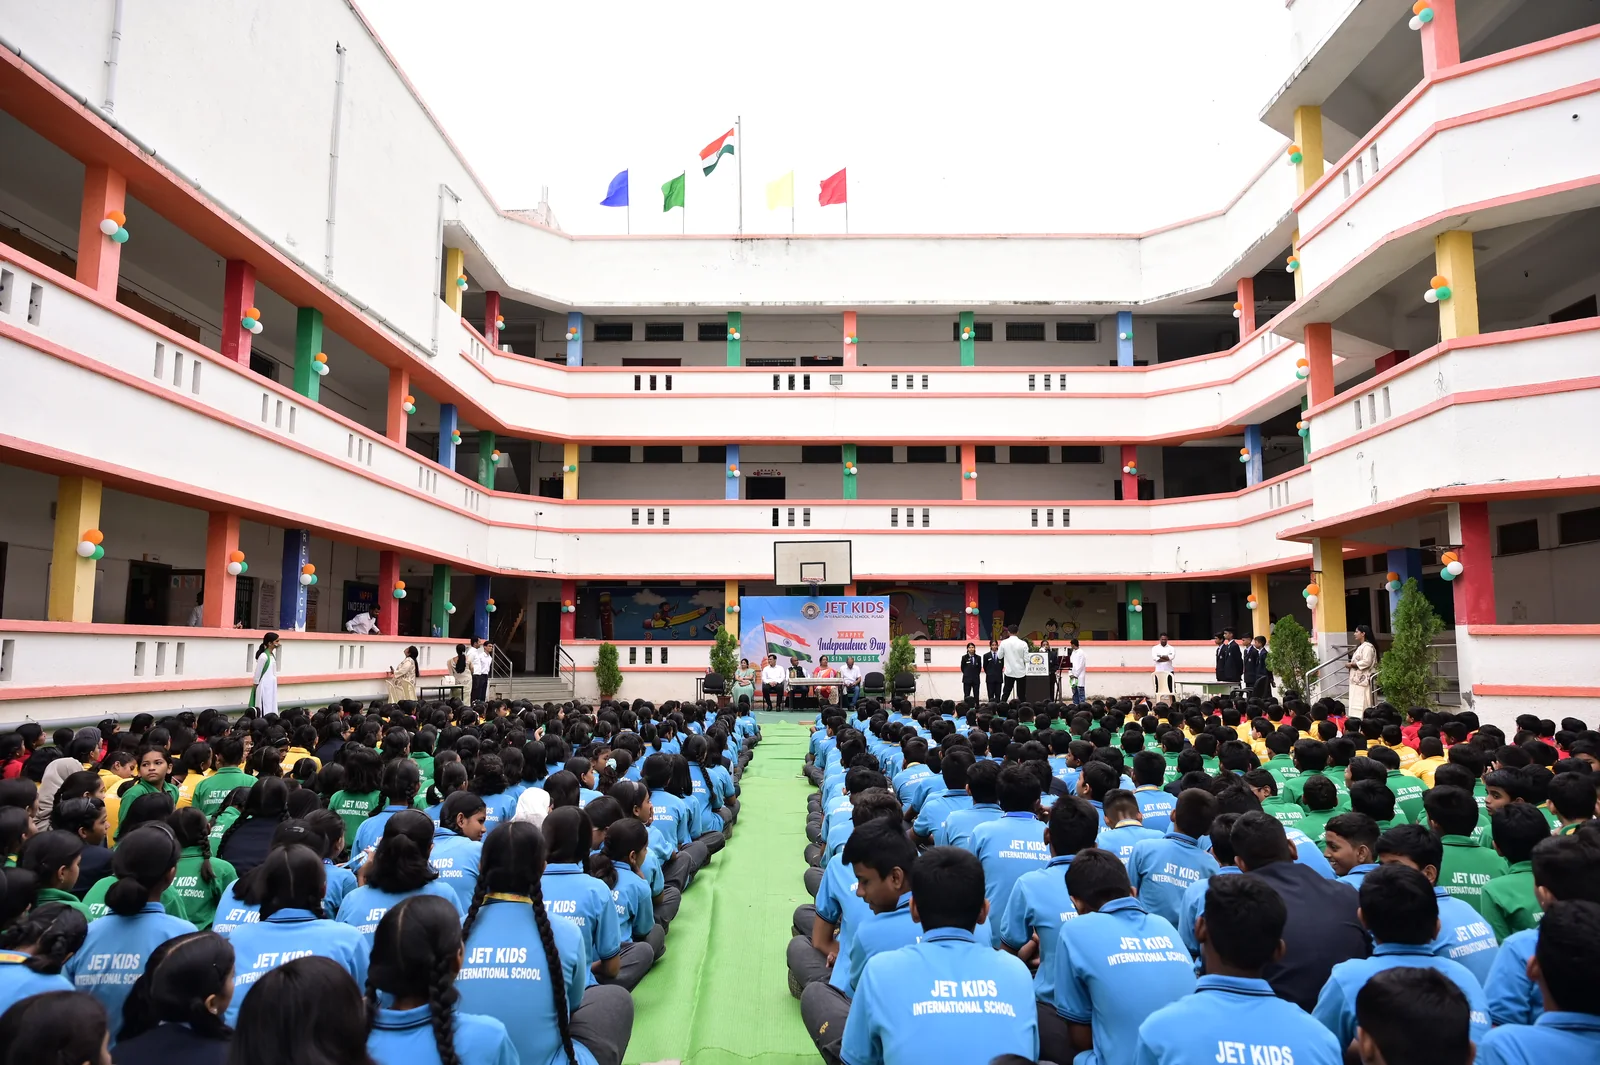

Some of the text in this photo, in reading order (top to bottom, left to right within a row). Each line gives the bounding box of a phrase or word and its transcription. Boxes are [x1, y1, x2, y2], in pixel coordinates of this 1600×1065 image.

[824, 602, 884, 613] JET KIDS
[817, 637, 886, 655] Independence Day
[208, 790, 221, 798] JET
[342, 800, 369, 809] JET KIDS
[1155, 802, 1171, 810] KIDS
[1009, 840, 1047, 852] JET KIDS
[1119, 846, 1134, 855] JET
[998, 850, 1038, 860] INTERNATIONAL
[433, 858, 454, 869] KIDS
[442, 870, 463, 878] SCHOOL
[1163, 862, 1200, 881] JET KIDS
[1451, 872, 1468, 884] JET
[176, 876, 198, 887] KIDS
[1152, 873, 1188, 889] INTERNATIONAL
[183, 889, 205, 898] SCHOOL
[553, 900, 576, 913] KIDS
[225, 908, 246, 921] JET
[366, 908, 387, 921] JET
[1455, 921, 1490, 942] JET KIDS
[1120, 936, 1174, 950] JET KIDS
[87, 953, 140, 970] JET KIDS
[253, 952, 279, 969] JET
[468, 947, 527, 964] JET KIDS
[1107, 952, 1167, 966] INTERNATIONAL
[511, 967, 541, 981] SCHOOL
[931, 980, 998, 998] JET KIDS
[913, 1000, 1016, 1018] INTERNATIONAL SCHOOL
[1215, 1040, 1295, 1065] JET KIDS
